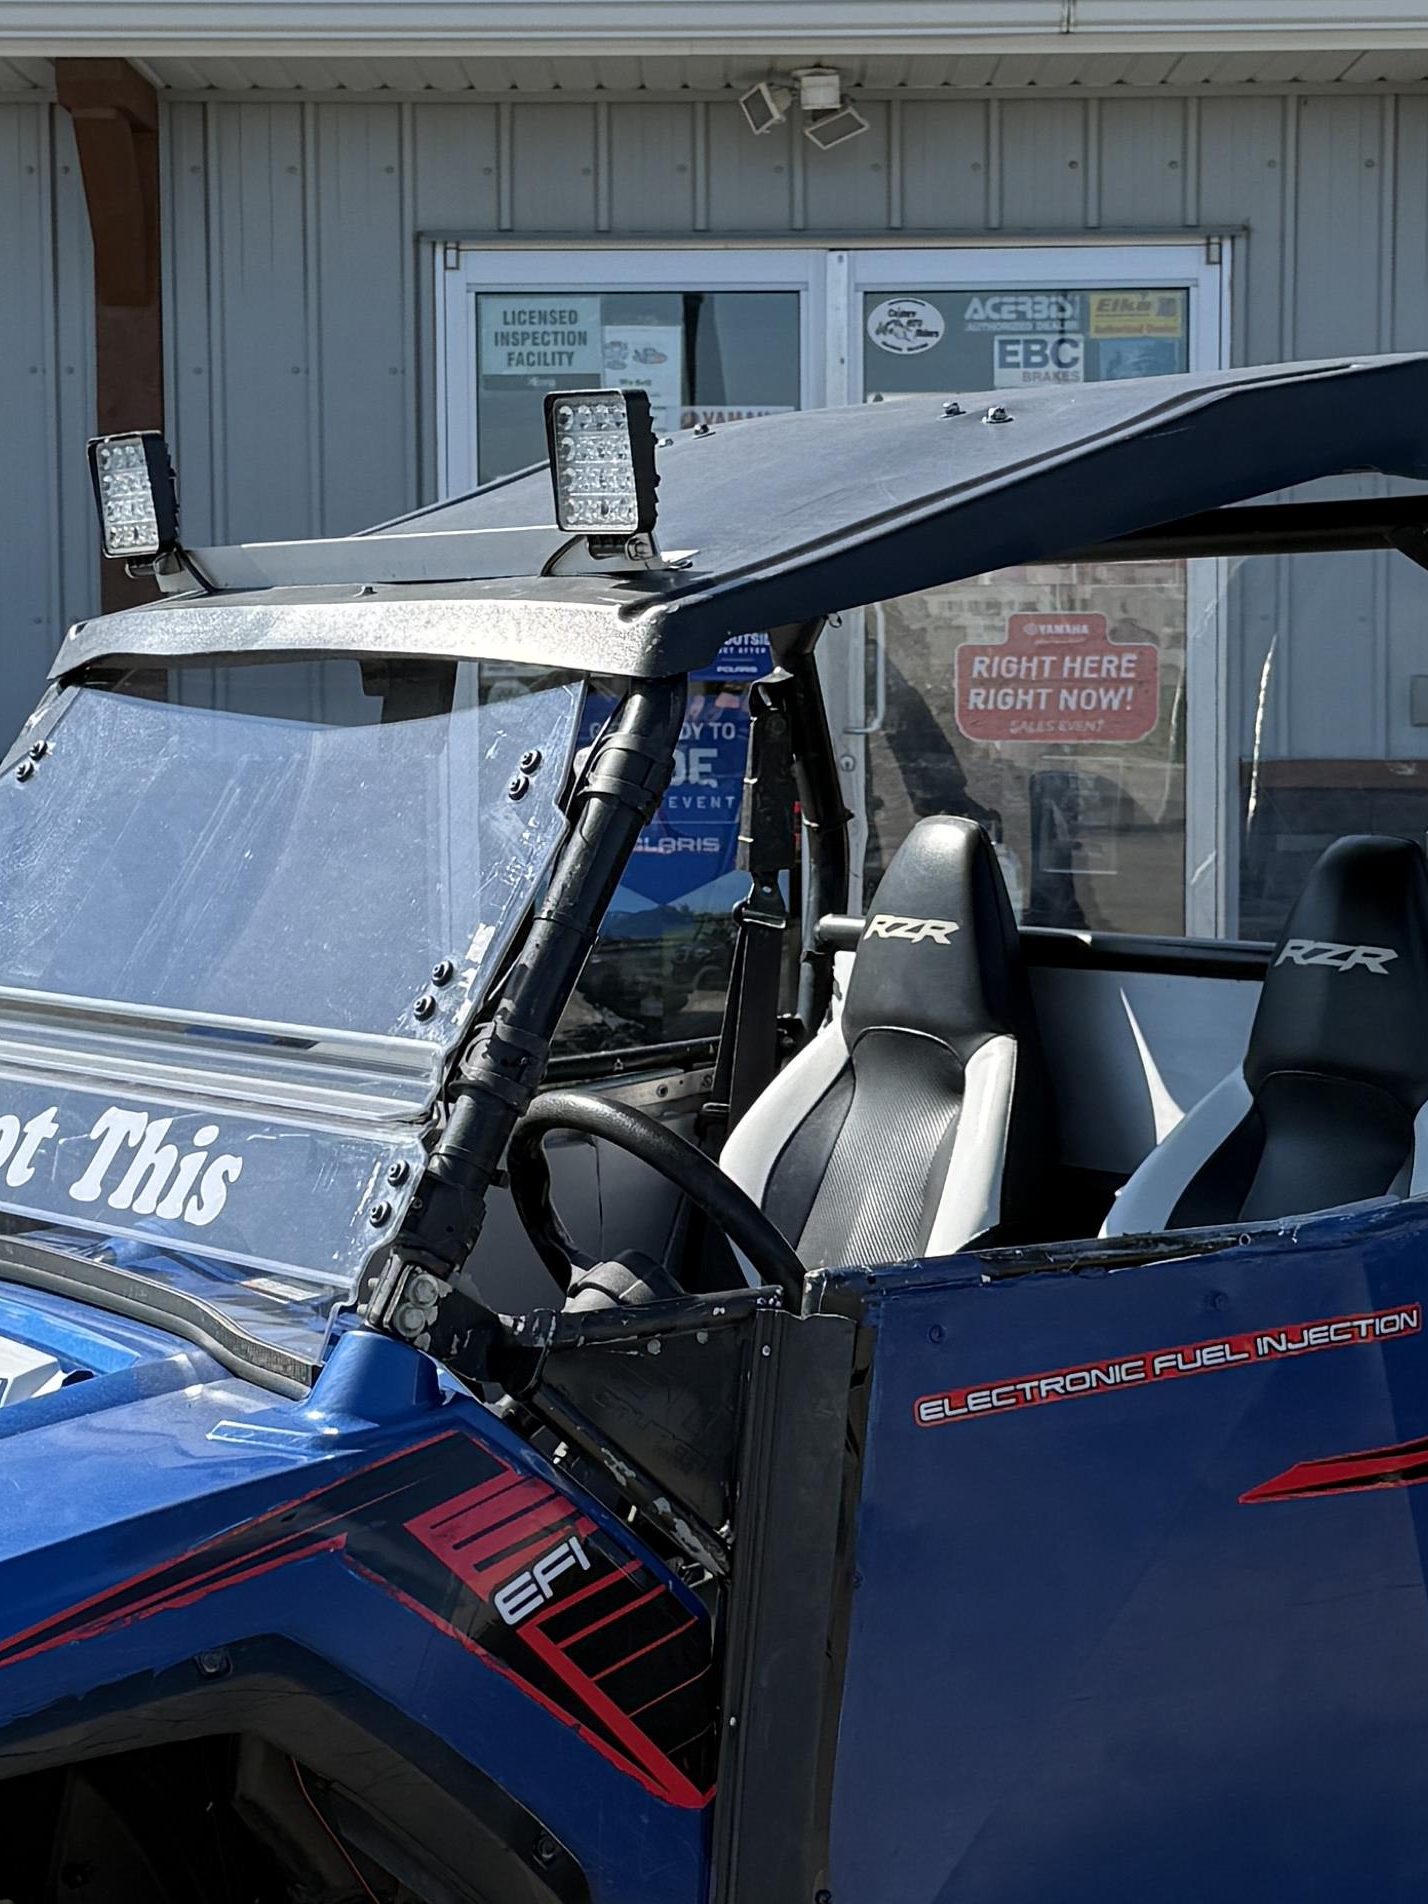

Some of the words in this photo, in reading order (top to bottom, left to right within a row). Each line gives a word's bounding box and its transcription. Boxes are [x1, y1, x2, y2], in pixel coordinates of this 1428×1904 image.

[503, 309, 578, 326] LICENSED
[494, 331, 588, 346] INSPECTION
[506, 351, 575, 368] FACILITY
[997, 338, 1081, 369] EBC
[1021, 370, 1082, 384] BRAKES
[1038, 624, 1090, 636] YAMAHA
[971, 656, 1056, 681] RIGHT
[1062, 653, 1140, 679] HERE
[967, 687, 1054, 711] RIGHT
[1058, 686, 1134, 712] NOW!
[708, 722, 736, 740] TO
[1009, 719, 1056, 734] SALES
[1058, 718, 1106, 733] EVENT
[668, 796, 736, 809] EVENT
[863, 914, 960, 946] RZR
[1273, 938, 1398, 976] RZR
[69, 1106, 243, 1228] This
[918, 1358, 1146, 1423] ELECTRONIC
[1152, 1342, 1250, 1379] FUEL
[1255, 1309, 1419, 1358] INJECTION
[493, 1536, 592, 1626] EFI
